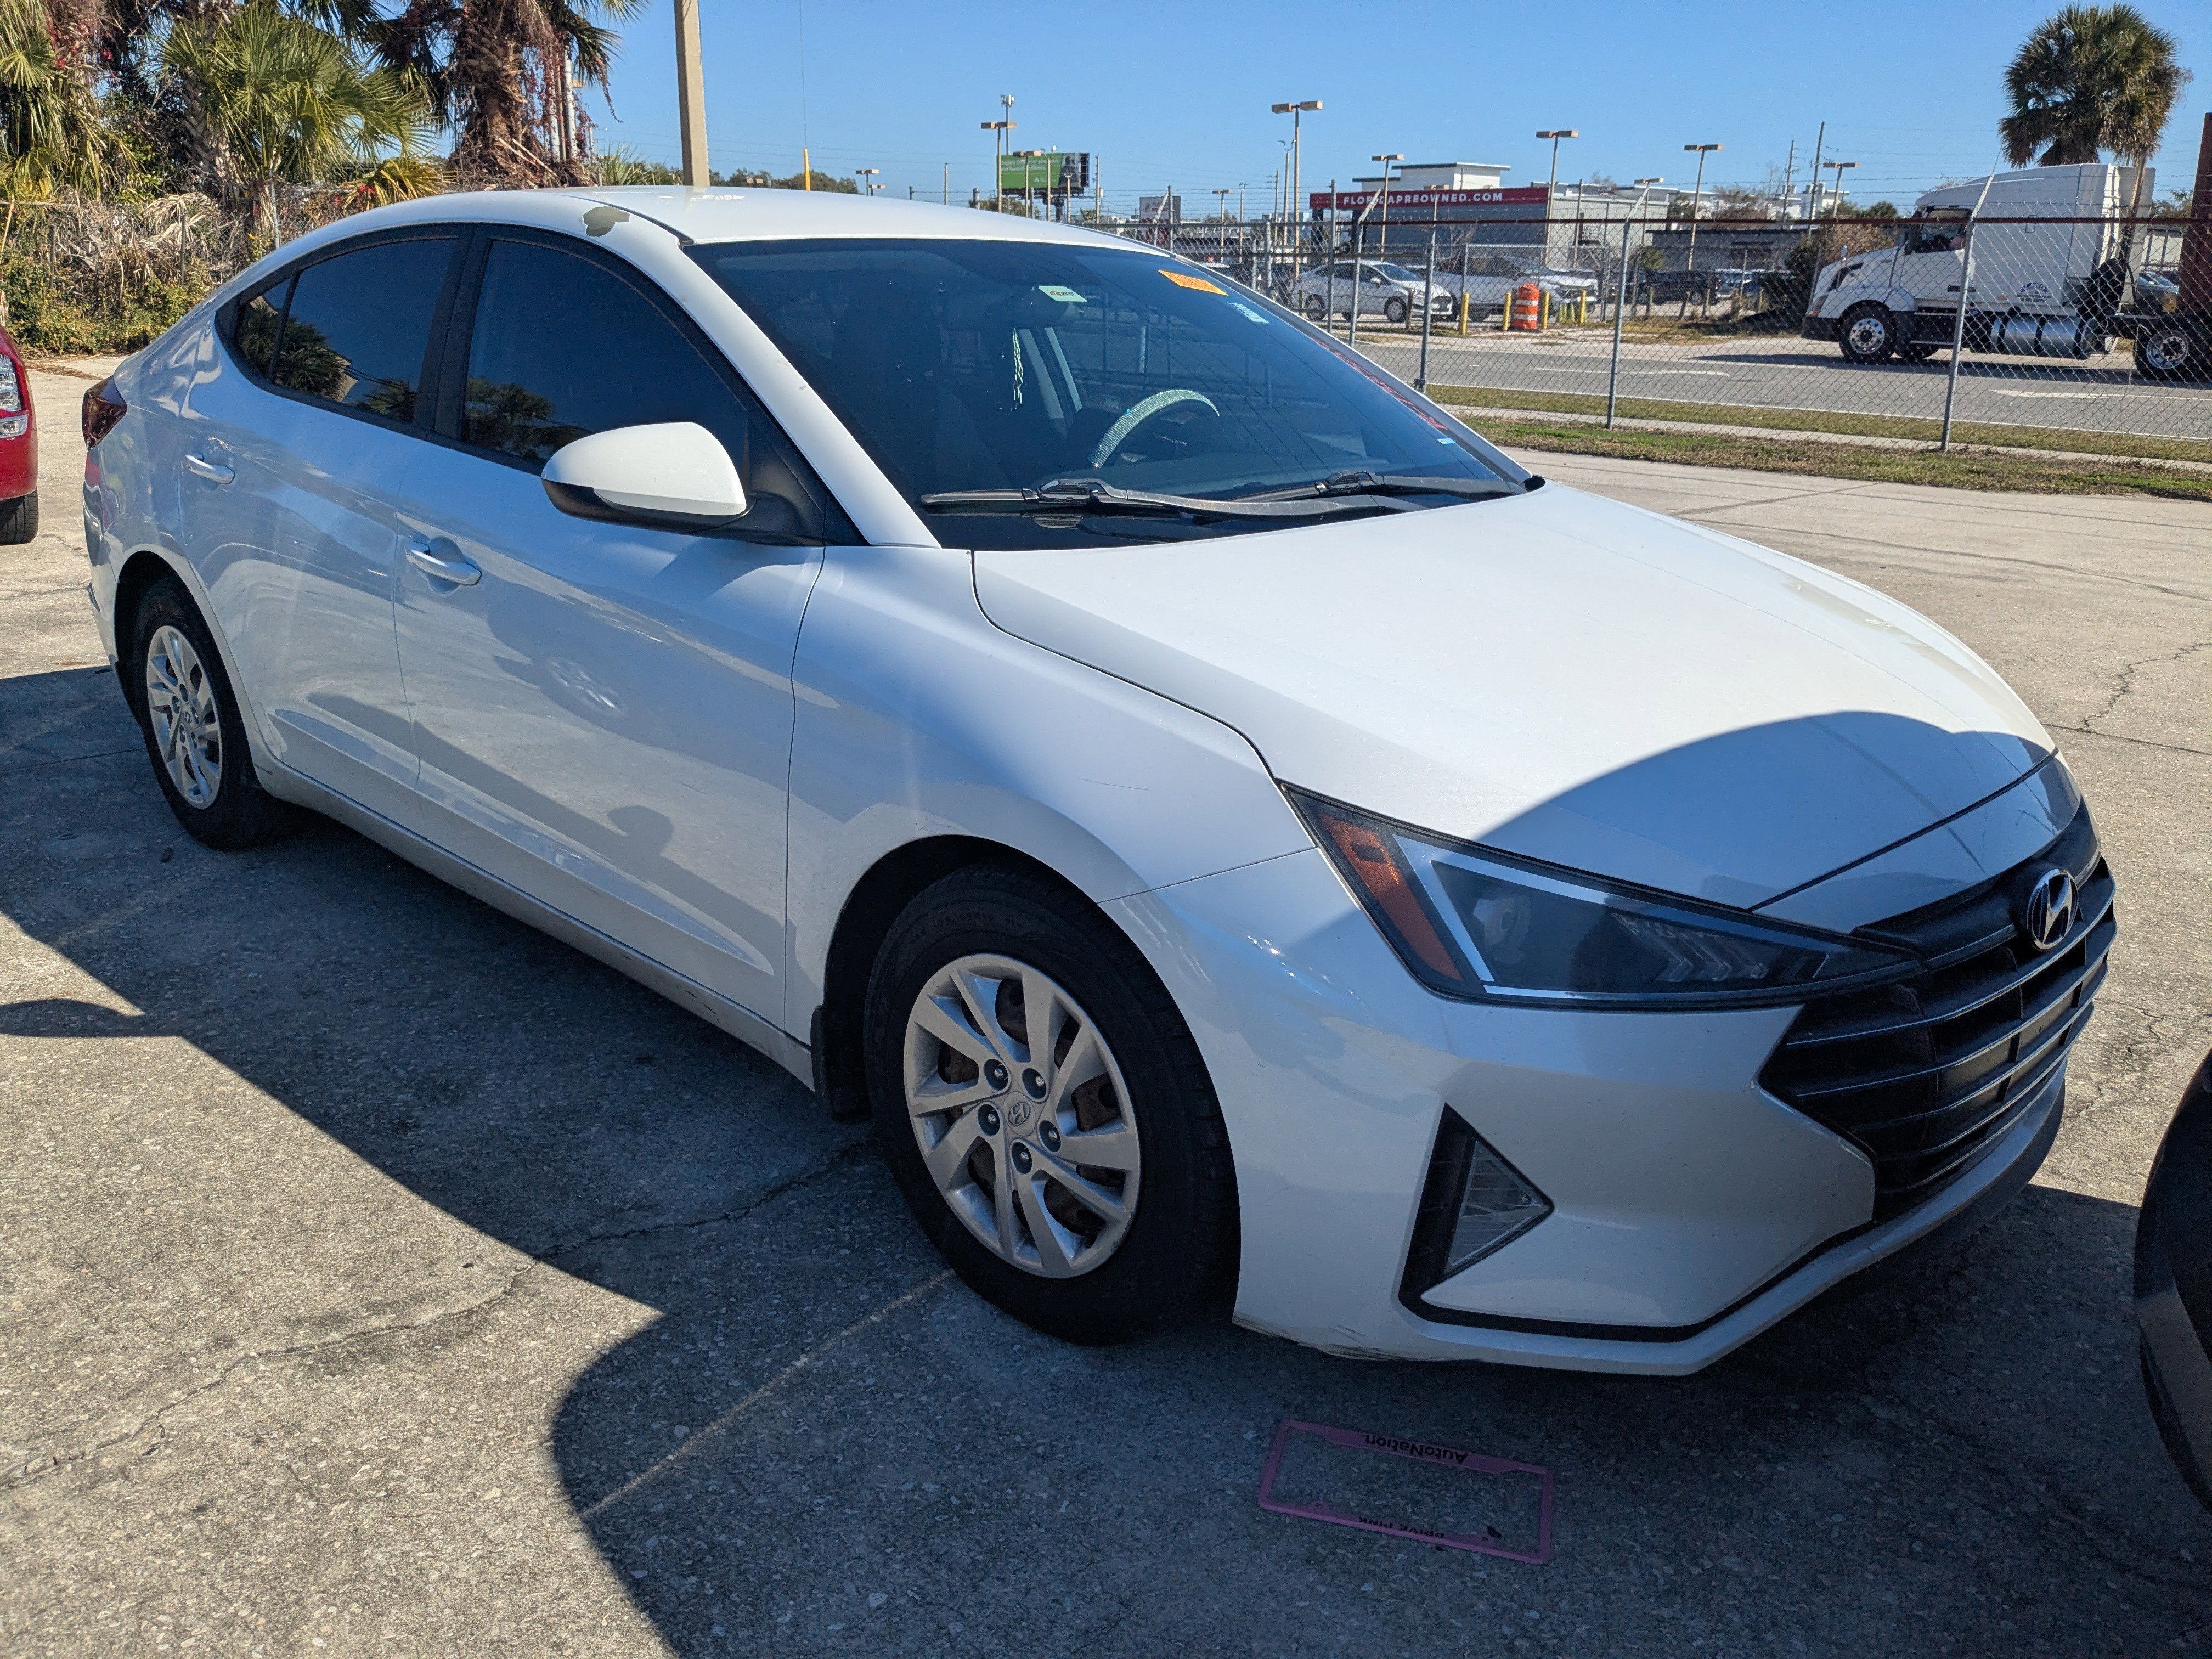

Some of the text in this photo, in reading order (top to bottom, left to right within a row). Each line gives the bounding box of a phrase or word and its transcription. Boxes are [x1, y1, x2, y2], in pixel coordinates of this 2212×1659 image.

[1344, 192, 1503, 205] FLORDAPREOWNED.COM
[1365, 1434, 1469, 1464] AutoNation
[1359, 1516, 1444, 1539] DRIVE PINK
